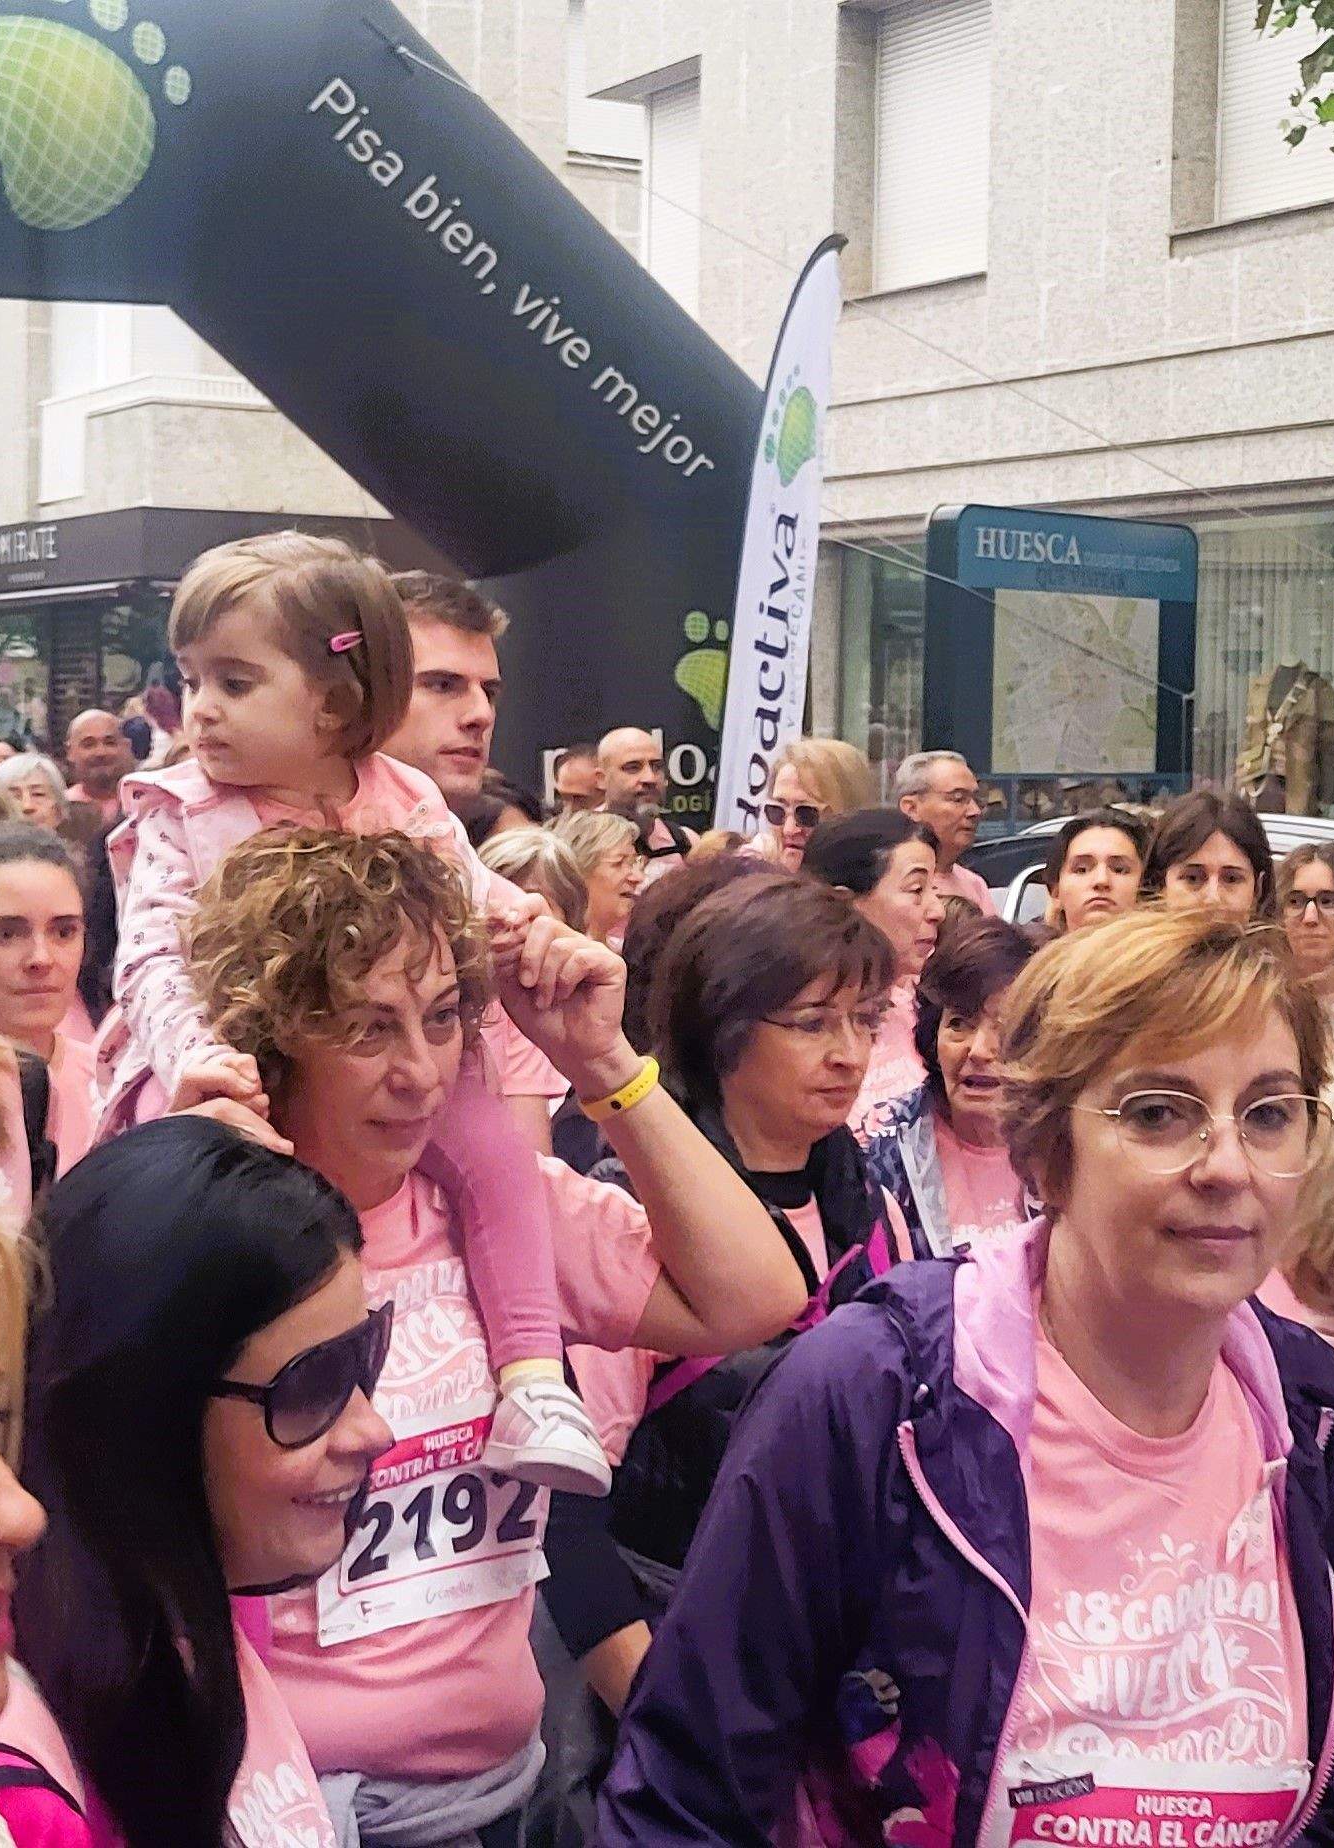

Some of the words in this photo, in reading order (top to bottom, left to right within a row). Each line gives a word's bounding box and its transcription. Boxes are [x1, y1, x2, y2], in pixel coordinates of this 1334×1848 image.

[309, 77, 405, 188] Pisa
[404, 175, 499, 296] bien,
[512, 283, 592, 371] vive
[589, 365, 717, 479] mejor
[975, 526, 1082, 566] HUESCA
[422, 1428, 473, 1452] HUESCA
[438, 1447, 460, 1466] EL
[348, 1472, 536, 1583] 2192
[1136, 1794, 1213, 1818] HUESCA
[1033, 1813, 1152, 1846] CONTRA
[1159, 1821, 1188, 1848] EL
